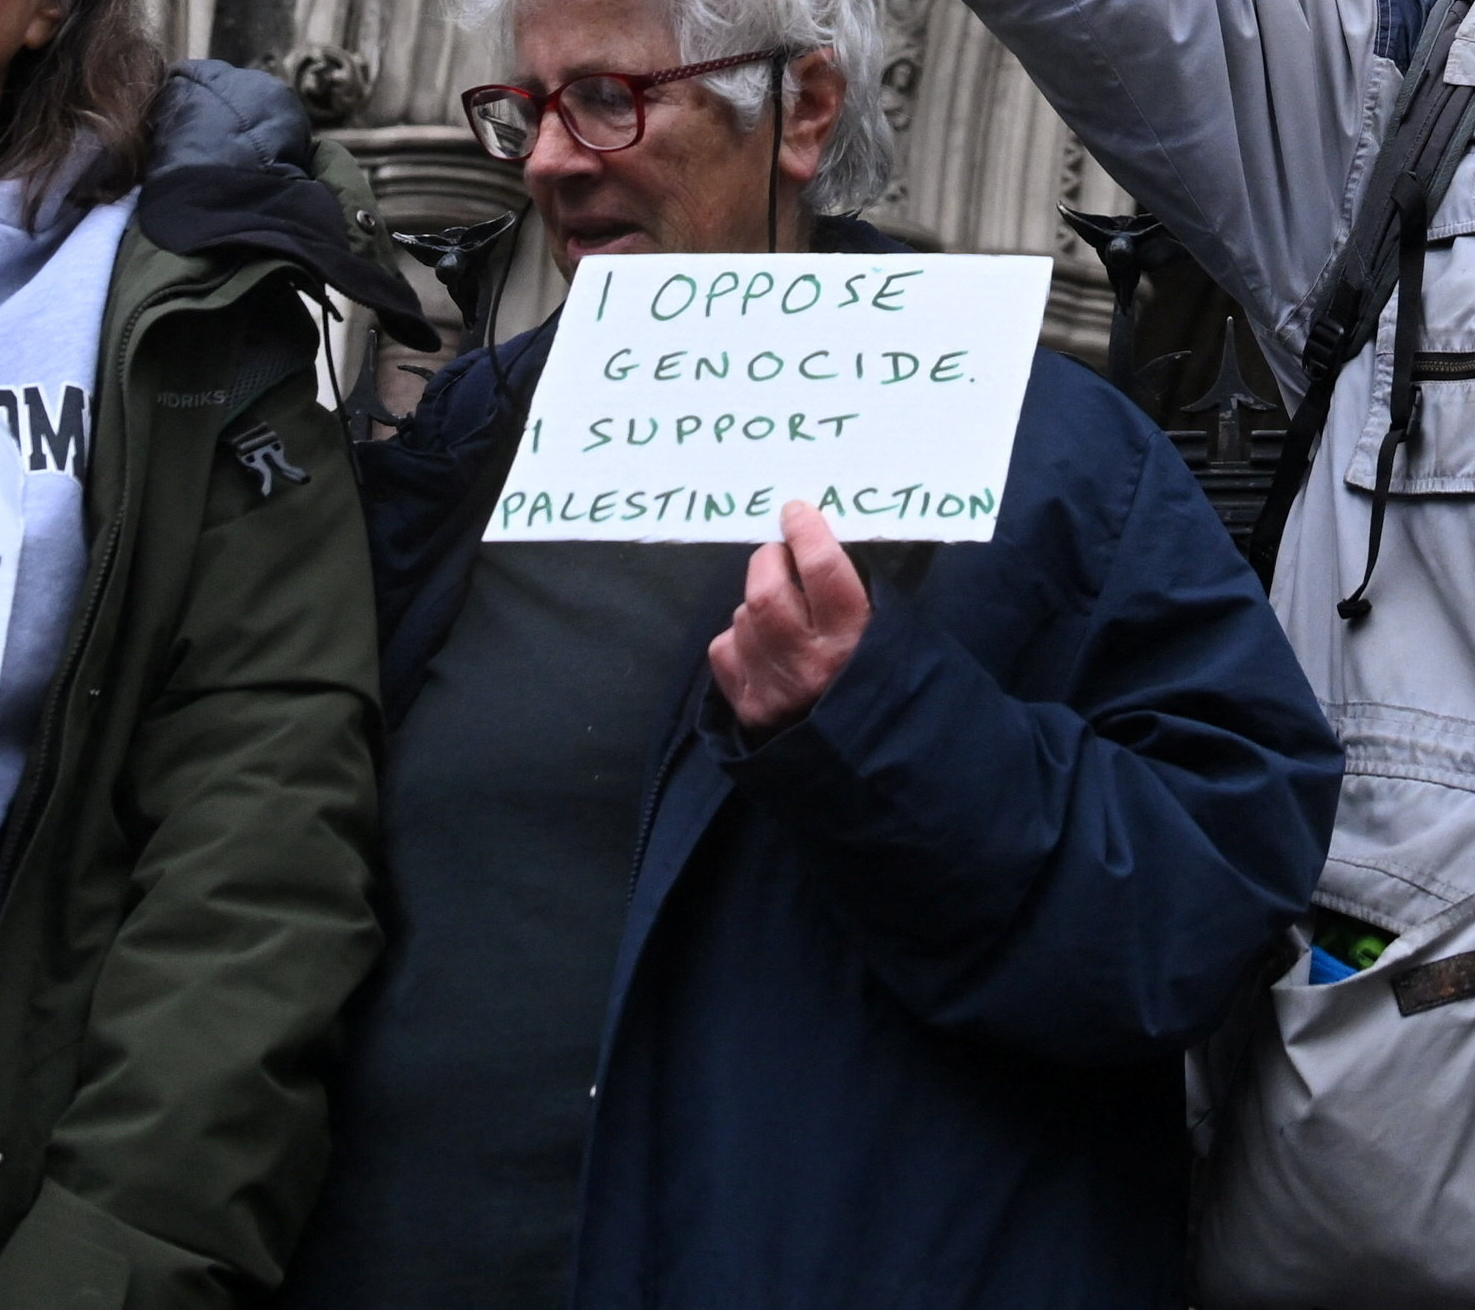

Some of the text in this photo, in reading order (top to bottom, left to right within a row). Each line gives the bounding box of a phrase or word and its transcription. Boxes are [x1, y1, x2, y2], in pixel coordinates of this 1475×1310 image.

[597, 270, 924, 320] I OPPOSE
[582, 413, 859, 452] SUPPORT
[502, 486, 774, 529] PALESTINE
